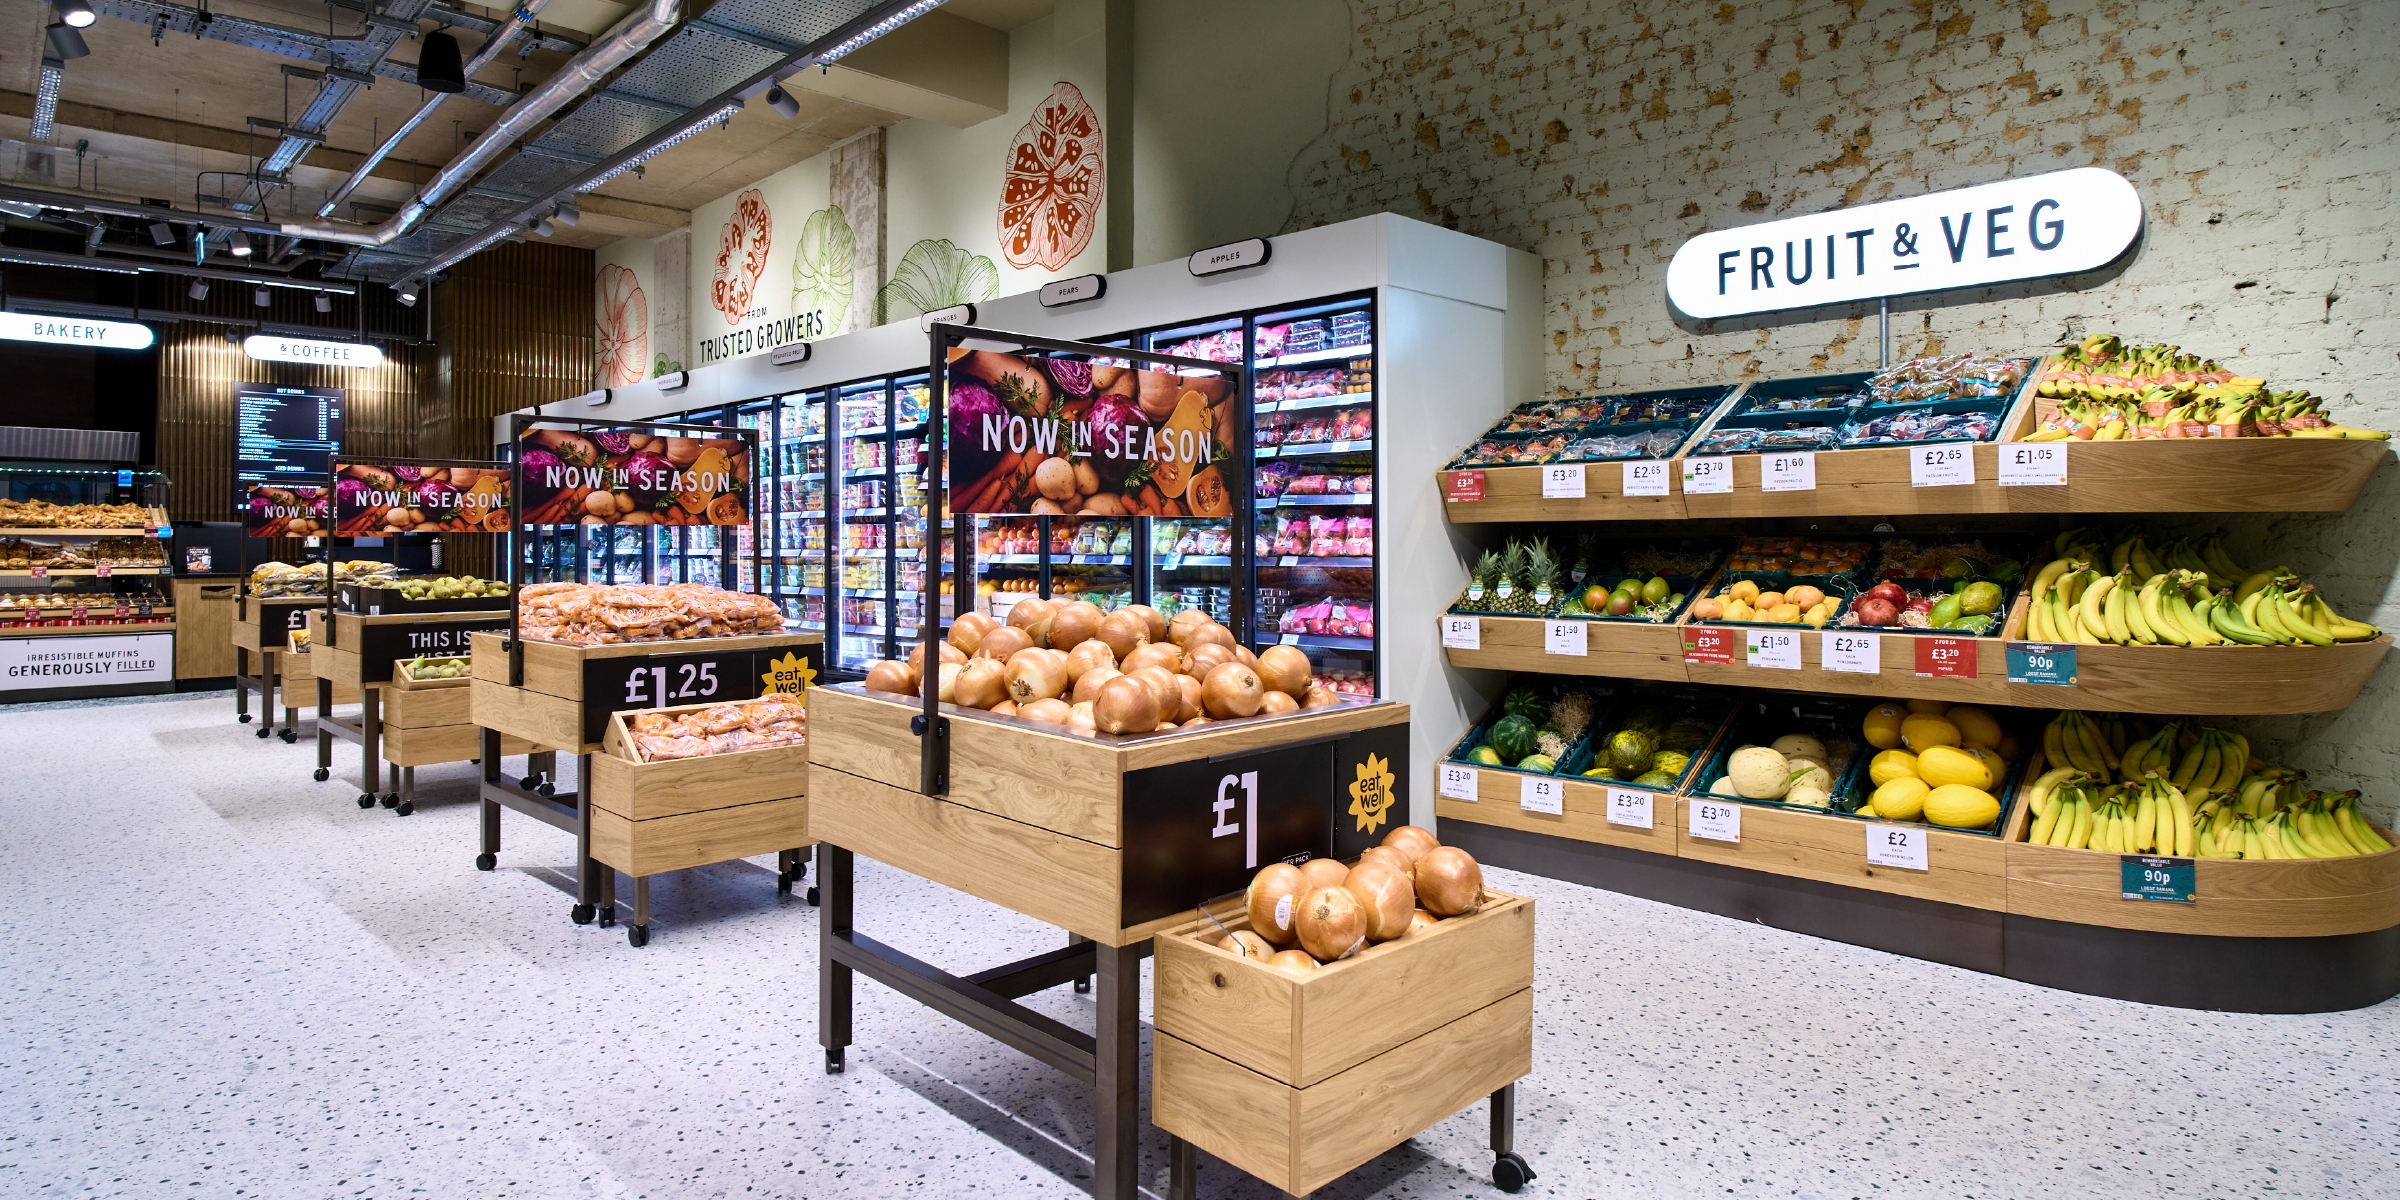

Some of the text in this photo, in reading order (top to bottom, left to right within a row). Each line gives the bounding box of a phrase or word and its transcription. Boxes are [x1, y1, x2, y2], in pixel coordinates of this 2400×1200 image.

[1718, 198, 2065, 295] FRUIT & VEG
[1210, 252, 1240, 264] APPLES
[1058, 286, 1079, 296] PEARS
[747, 307, 767, 320] FROM
[933, 314, 957, 322] ORANGES
[34, 322, 106, 340] BAKERY
[700, 309, 823, 363] TRUSTED GROWERS
[293, 344, 350, 360] COFFEE
[982, 413, 1212, 464] NOW IN SEASON
[1925, 450, 1961, 465] £2.65
[2016, 449, 2052, 464] £1.05
[1695, 462, 1722, 475] £3.70
[1775, 458, 1803, 471] £1.60
[1553, 470, 1576, 481] £3.20
[1634, 466, 1661, 478] £2.65
[546, 465, 730, 494] NOW IN SEASON
[1457, 479, 1473, 487] £3.20
[356, 491, 502, 509] NOW IN SEASON
[264, 506, 300, 518] NOW
[306, 506, 316, 515] IN
[1452, 622, 1471, 632] £1.25
[1555, 626, 1578, 636] £1.50
[408, 631, 471, 648] THIS IS
[1698, 637, 1720, 647] £3.20
[1761, 636, 1789, 648] £1.50
[1835, 638, 1869, 652] £2.65
[28, 650, 139, 661] IRRESISTIBLE MUFFINS
[1932, 648, 1959, 659] £3.20
[9, 660, 155, 676] GENEROUSLY FILLED
[2029, 656, 2053, 670] 90p
[775, 667, 801, 681] eat
[625, 662, 718, 708] £1.25
[775, 677, 805, 693] well
[1449, 770, 1470, 781] £3.20
[1360, 774, 1380, 794] eat
[1536, 782, 1549, 795] £3
[1360, 785, 1385, 807] well
[1618, 794, 1644, 807] £3.20
[1212, 771, 1258, 869] £1
[1701, 806, 1730, 820] £3.70
[1888, 832, 1907, 846] £2
[1295, 855, 1309, 864] PACK
[2144, 870, 2170, 885] 90p
